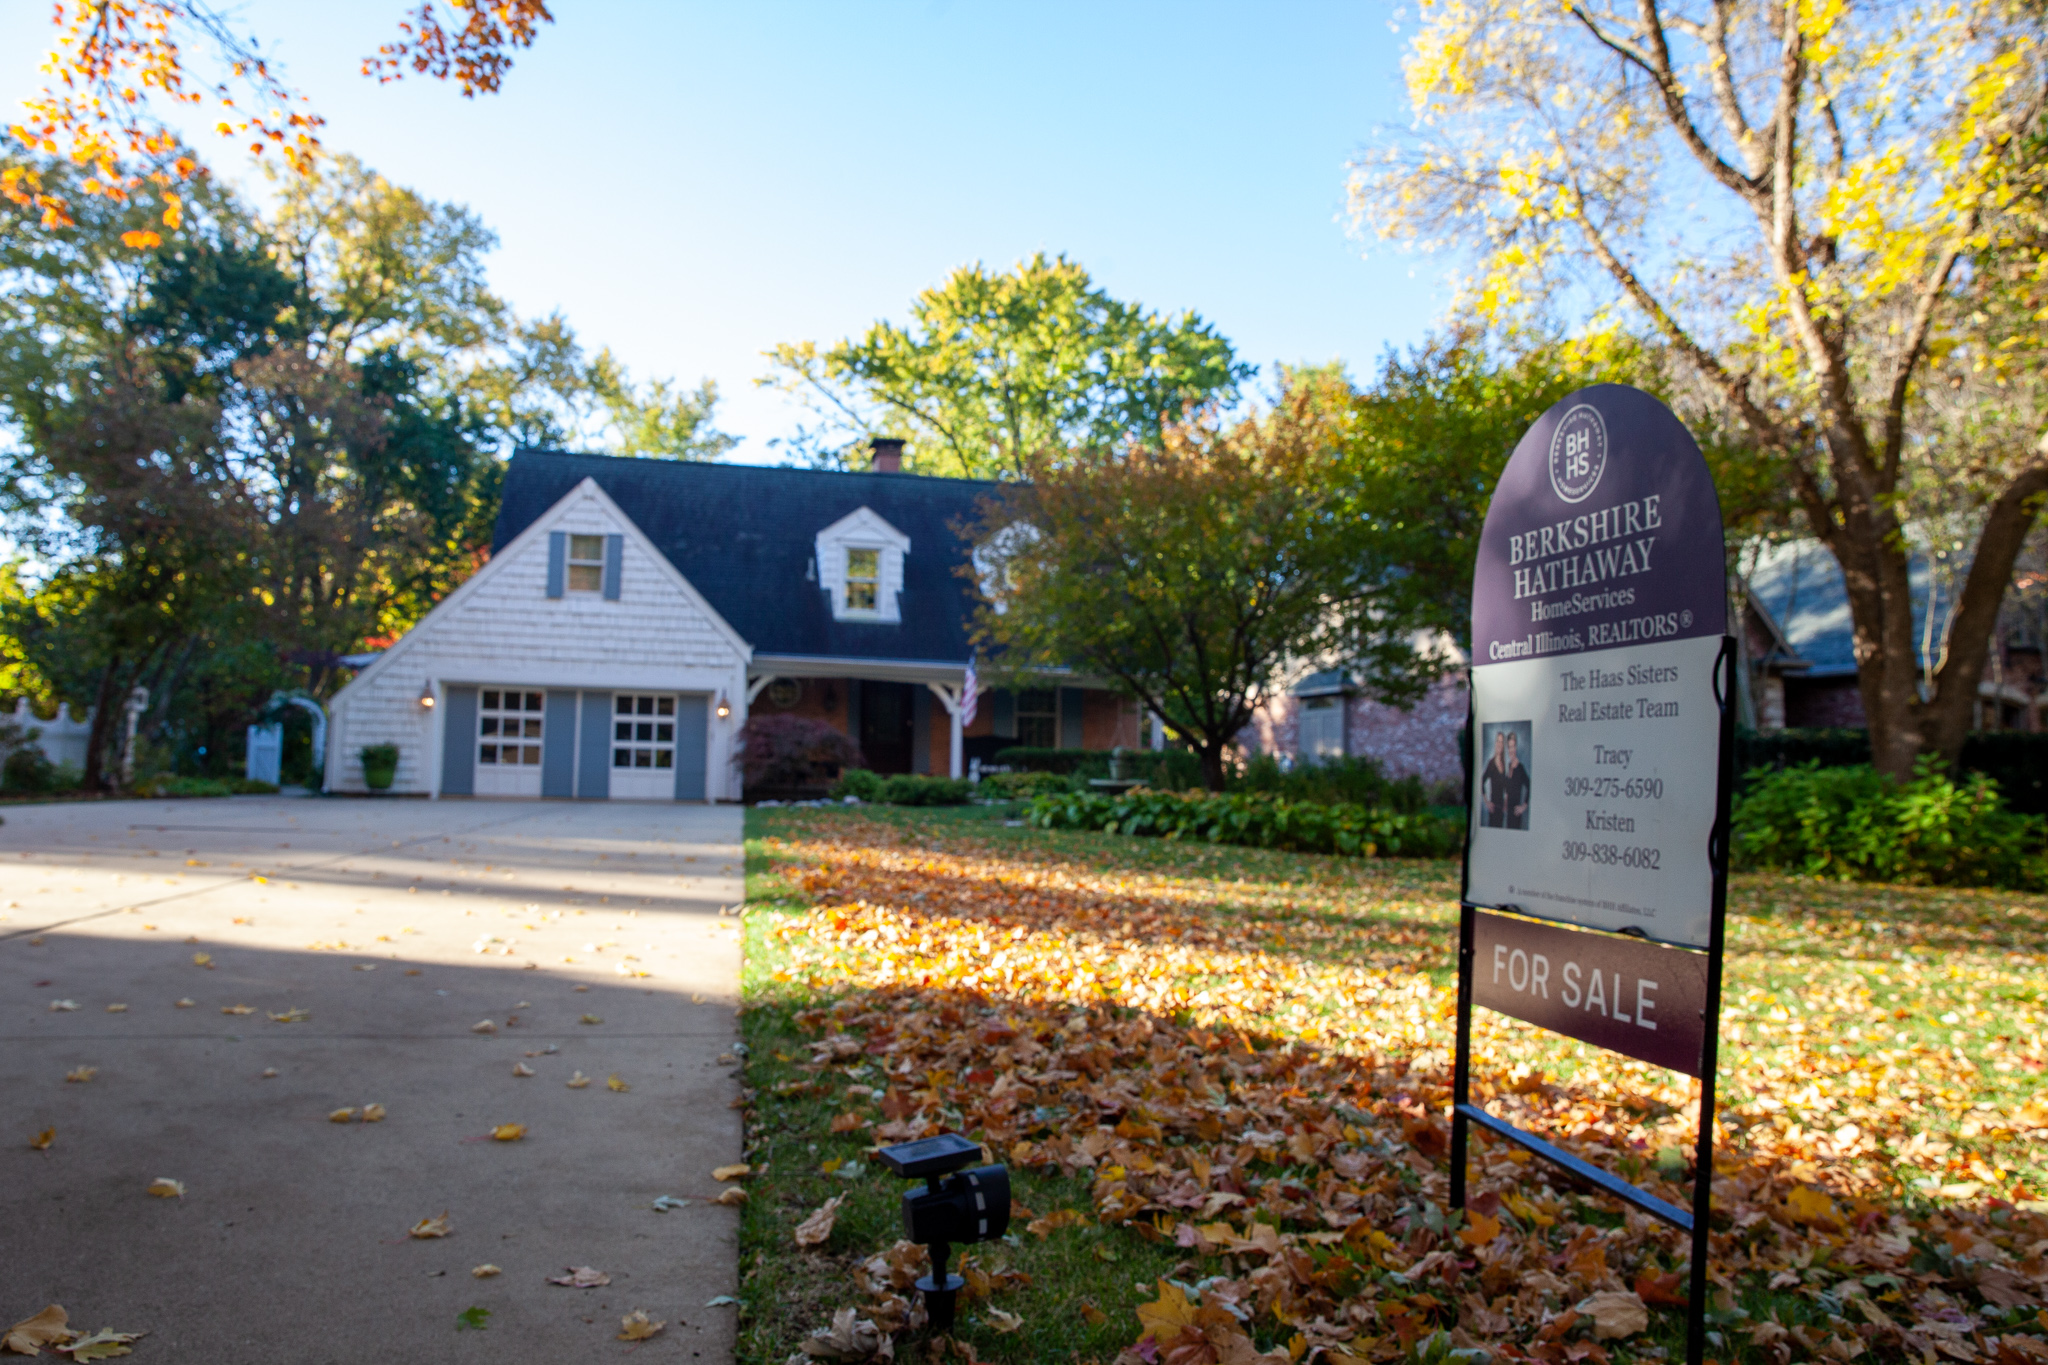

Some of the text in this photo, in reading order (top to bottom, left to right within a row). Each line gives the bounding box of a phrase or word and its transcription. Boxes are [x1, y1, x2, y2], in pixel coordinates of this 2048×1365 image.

[1566, 427, 1590, 457] BH
[1566, 451, 1590, 480] HS
[1509, 494, 1662, 566] BERKSHIRE
[1514, 536, 1656, 599] HATHAWAY
[1531, 587, 1635, 622] HomeServices
[1489, 634, 1533, 660] Central
[1535, 628, 1585, 654] Illinois,
[1561, 664, 1678, 692] The Haas Sisters
[1558, 698, 1679, 723] Real Estate Team
[1593, 745, 1633, 769] Tracy
[1564, 777, 1663, 800] 309-275-6590
[1585, 809, 1635, 833] Kristen
[1562, 841, 1661, 870] 309-838-6082
[1493, 944, 1658, 1030] FOR SALE
